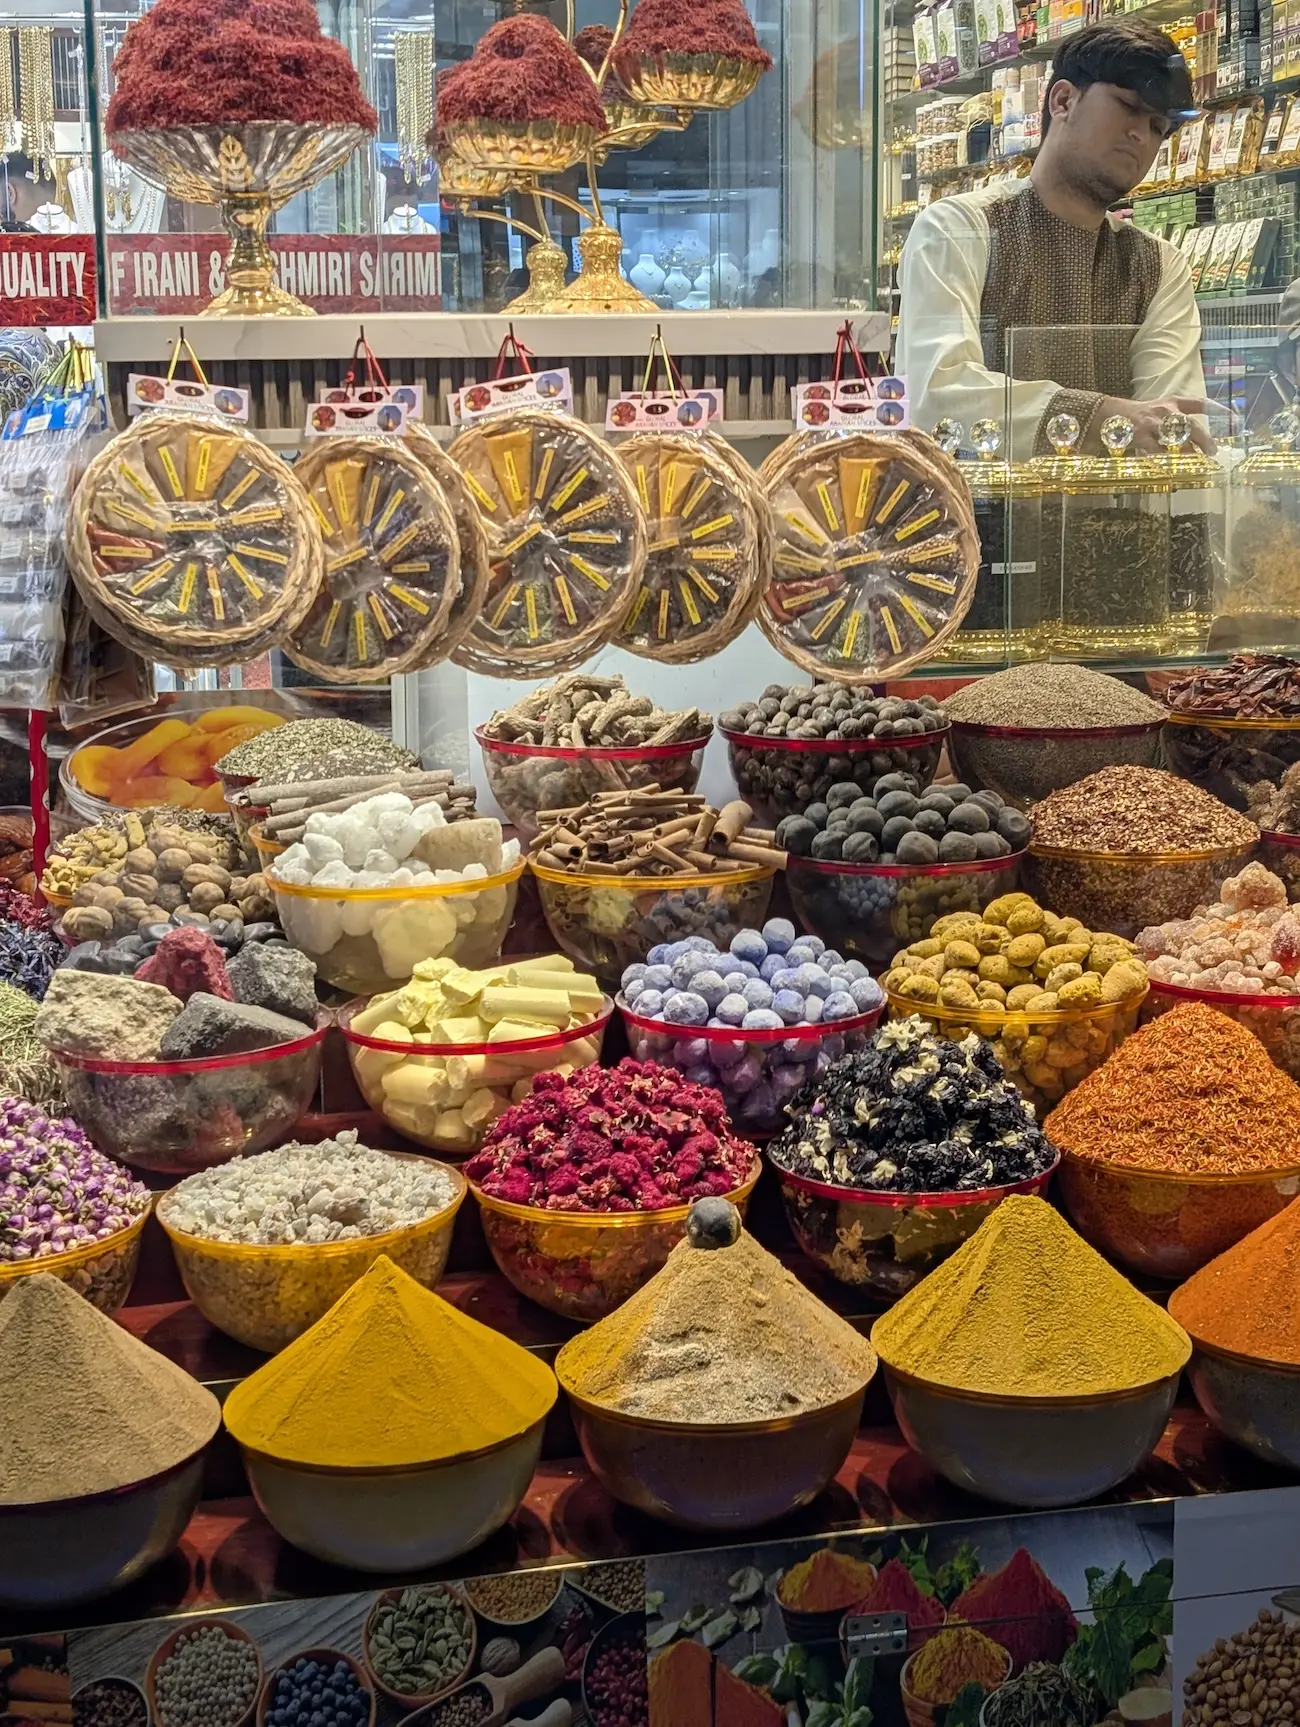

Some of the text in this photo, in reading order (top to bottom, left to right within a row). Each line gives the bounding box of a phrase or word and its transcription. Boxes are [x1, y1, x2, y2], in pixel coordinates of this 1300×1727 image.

[0, 251, 86, 298] UALITY
[134, 252, 200, 297] IRANI
[209, 250, 225, 297] &
